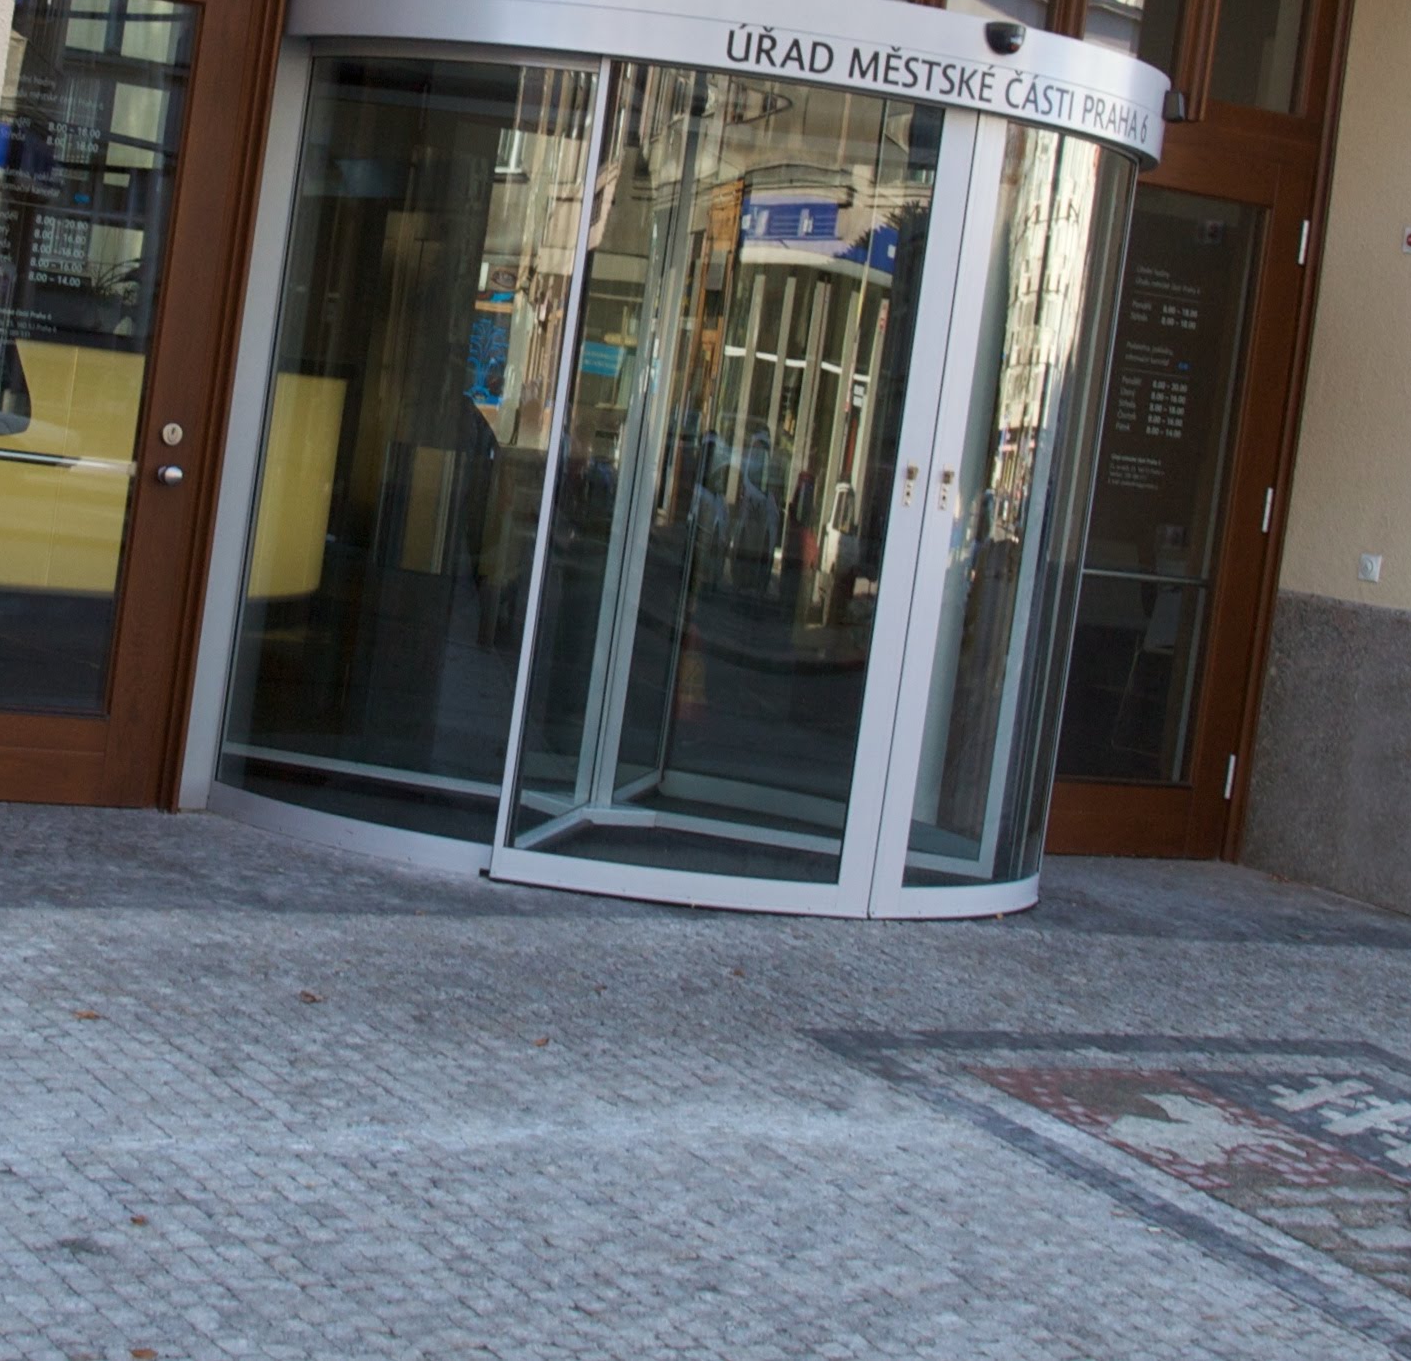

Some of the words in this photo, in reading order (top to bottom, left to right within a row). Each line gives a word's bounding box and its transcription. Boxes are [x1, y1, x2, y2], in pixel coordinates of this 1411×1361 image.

[726, 23, 835, 74] ÚŘAD
[847, 45, 995, 104] MĚSTSKÉ
[1005, 70, 1075, 120] ČÁSTI
[1082, 93, 1139, 140] PRAHA
[1140, 113, 1149, 145] 6
[48, 121, 68, 134] 8.00
[36, 214, 56, 227] 8.00
[34, 227, 53, 240] 8.00
[32, 242, 51, 255] 8.00
[30, 256, 49, 269] 8.00
[28, 270, 48, 283] 8.00
[57, 275, 81, 288] 14.00
